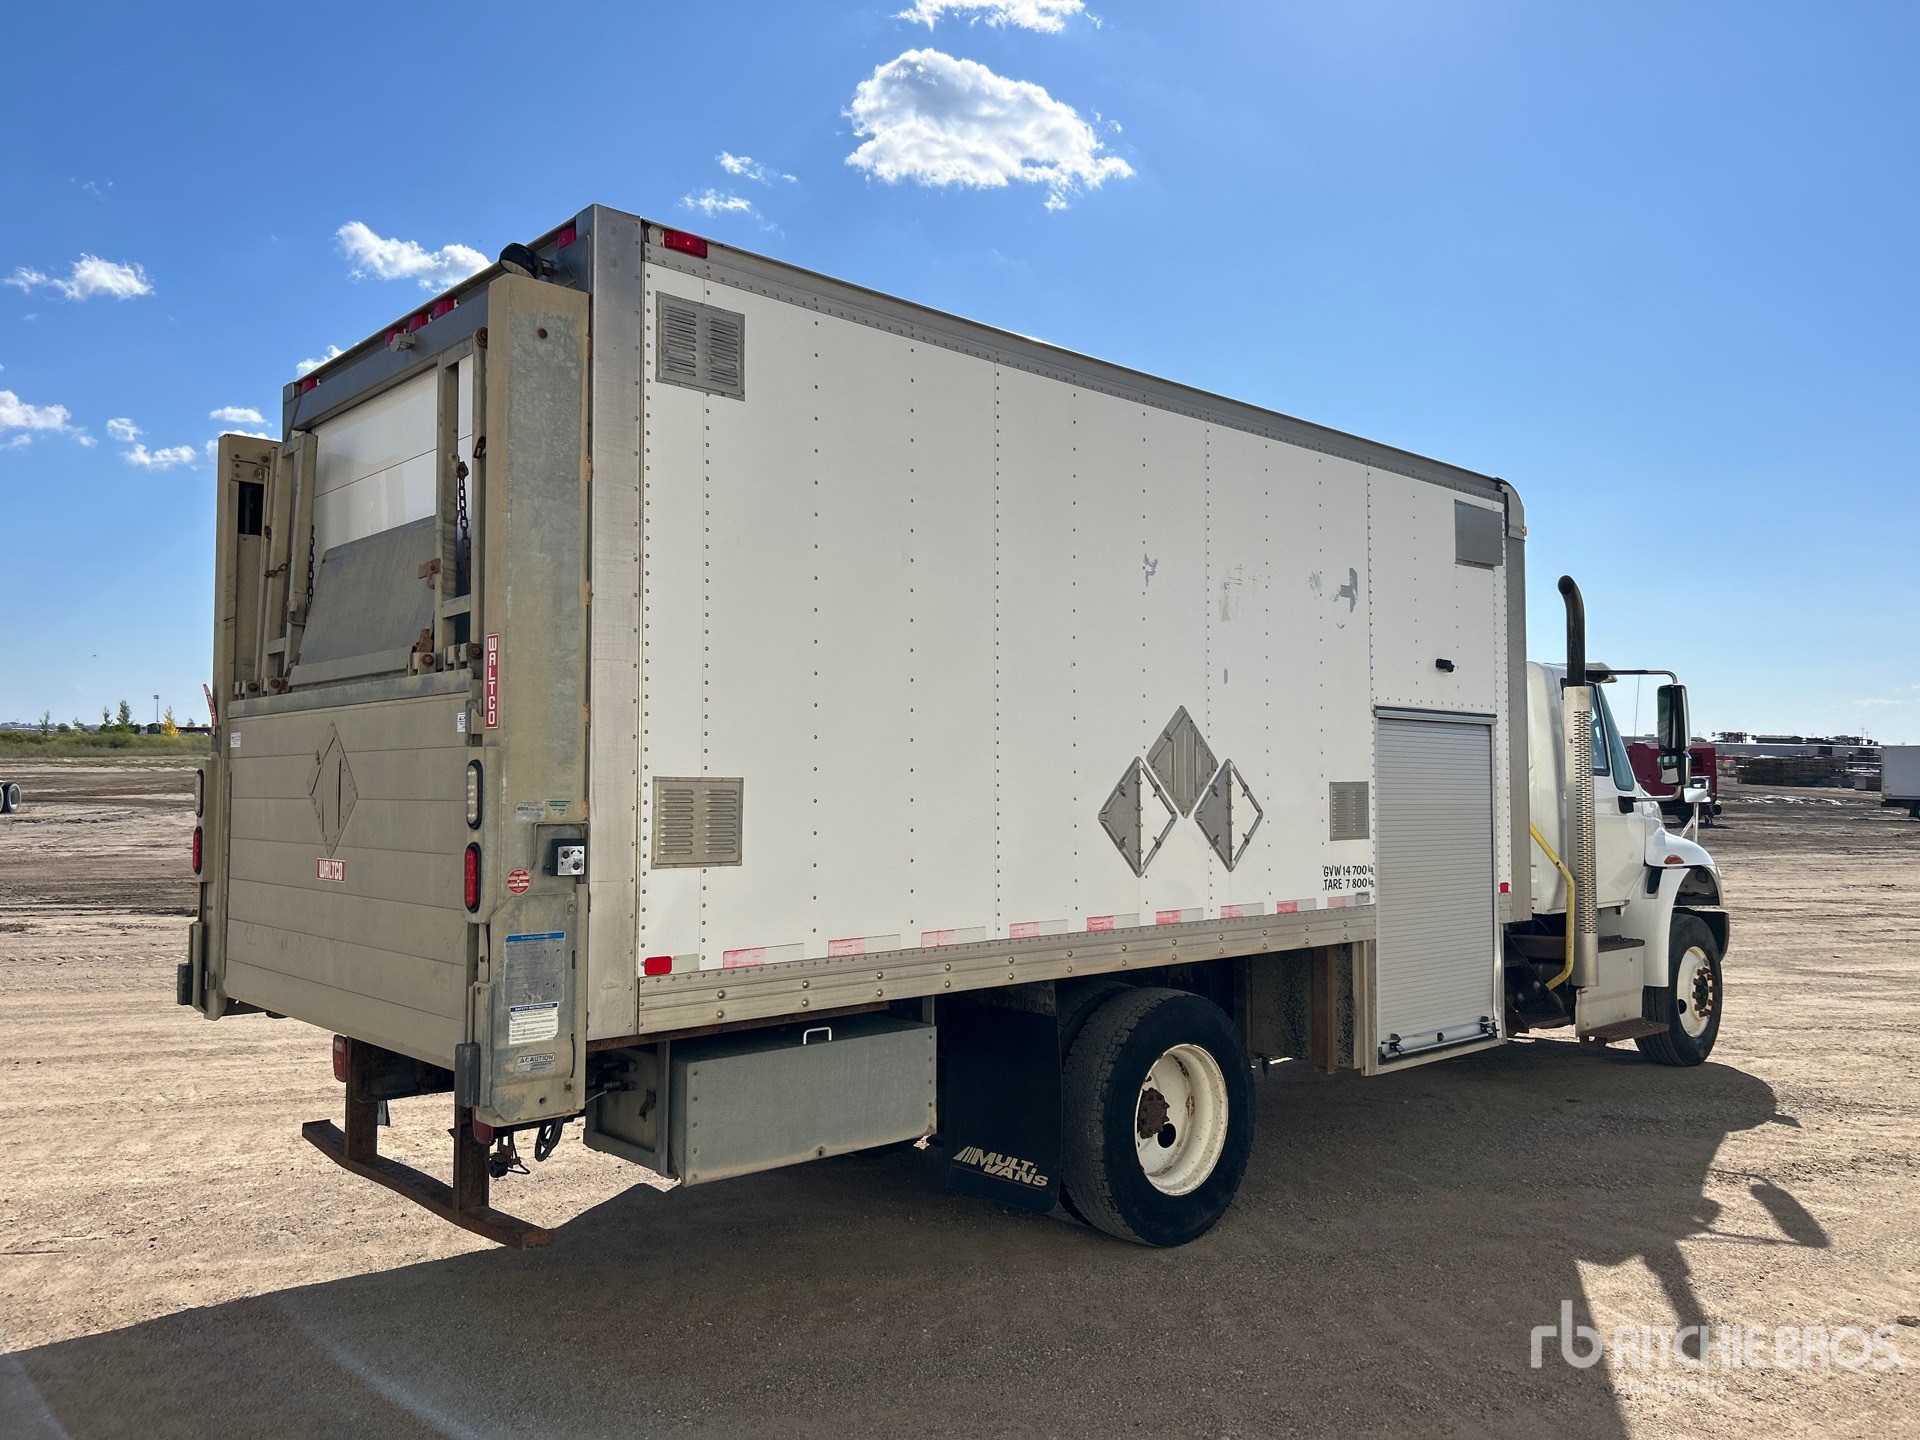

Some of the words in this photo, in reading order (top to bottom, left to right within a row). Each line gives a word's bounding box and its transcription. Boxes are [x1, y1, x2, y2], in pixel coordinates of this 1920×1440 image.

[488, 637, 498, 725] WALTCO
[319, 860, 343, 880] WALTCO
[1323, 864, 1341, 877] GVW
[1323, 879, 1342, 891] TARE
[525, 1054, 554, 1063] CAUTION
[984, 1164, 1048, 1187] VANS
